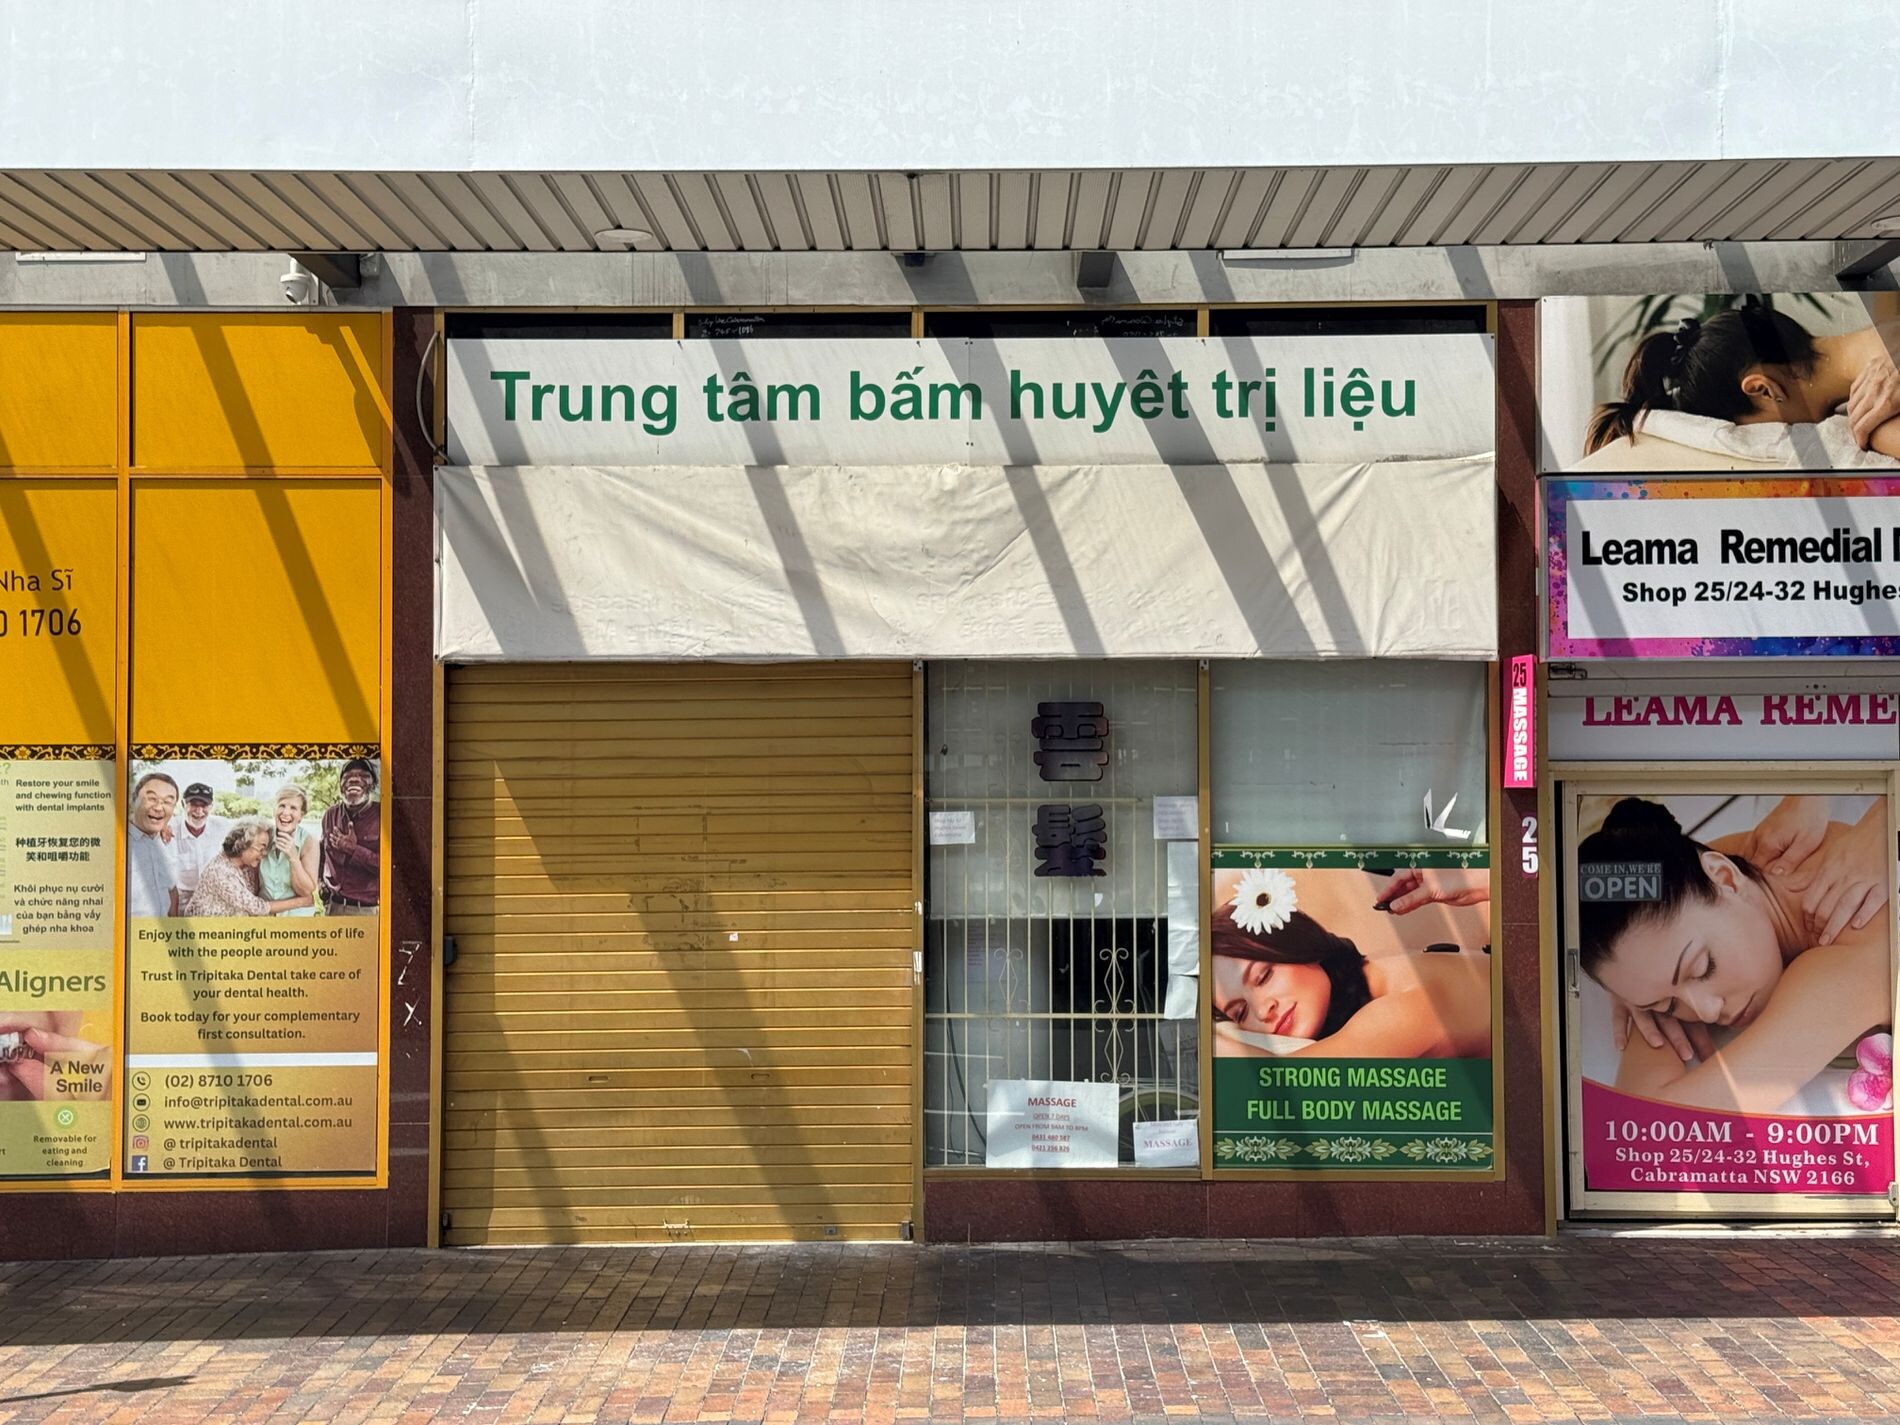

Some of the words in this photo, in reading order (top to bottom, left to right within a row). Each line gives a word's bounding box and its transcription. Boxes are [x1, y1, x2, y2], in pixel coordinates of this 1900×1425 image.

[490, 370, 677, 436] Trung
[703, 371, 820, 423] tâm
[850, 366, 982, 421] bấm
[1212, 367, 1276, 432] trị
[1304, 367, 1416, 431] liệu
[1582, 530, 1698, 565] Leama
[1720, 527, 1882, 564] Remedial
[51, 568, 73, 590] Sĩ
[1623, 582, 1686, 606] Shop
[1694, 580, 1806, 602] 25/24-32
[1814, 580, 1900, 605] Hughe
[20, 608, 81, 636] 1706
[1513, 662, 1526, 687] 25
[1582, 695, 1743, 725] LEAMA
[1513, 687, 1528, 782] MASSAGE
[15, 779, 50, 788] Restore
[53, 780, 73, 789] your
[75, 779, 100, 787] smile
[35, 791, 72, 801] chewing
[75, 791, 112, 799] function
[15, 803, 34, 811] with
[37, 803, 64, 811] dental
[67, 803, 105, 813] implants
[15, 837, 101, 848] 种植牙恢复您的微
[1580, 863, 1611, 875] COME
[39, 884, 63, 895] phục
[1584, 876, 1658, 899] OPEN
[82, 897, 103, 906] nhai
[50, 924, 68, 933] nha
[70, 923, 94, 933] khoa
[138, 929, 172, 942] Enjoy
[176, 929, 196, 940] the
[199, 928, 267, 941] meaningful
[270, 929, 327, 939] moments
[330, 928, 344, 939] of
[345, 928, 365, 938] life
[168, 946, 194, 957] with
[197, 946, 218, 957] the
[221, 946, 262, 960] people
[265, 946, 309, 957] around
[312, 947, 338, 959] you.
[141, 970, 173, 981] Trust
[176, 970, 187, 980] in
[190, 970, 244, 982] Tripitaka
[247, 969, 287, 980] Dental
[290, 969, 316, 979] take
[319, 970, 346, 979] care
[348, 969, 362, 979] of
[0, 969, 106, 998] Aligners
[193, 989, 221, 1001] your
[224, 987, 263, 998] dental
[266, 986, 309, 998] health.
[140, 1012, 172, 1022] Book
[174, 1012, 208, 1024] today
[212, 1011, 231, 1022] for
[233, 1013, 261, 1024] your
[264, 1010, 360, 1023] complementary
[198, 1029, 223, 1040] first
[225, 1029, 306, 1039] consultation.
[50, 1061, 63, 1075] A
[68, 1060, 104, 1075] New
[164, 1074, 194, 1088] (02)
[198, 1074, 233, 1087] 8710
[237, 1074, 273, 1087] 1706
[1259, 1067, 1341, 1088] STRONG
[1347, 1068, 1447, 1088] MASSAGE
[56, 1079, 103, 1093] Smile
[164, 1095, 353, 1110] info@tripitakadental.com.au
[1027, 1097, 1077, 1108] MASSAGE
[1247, 1100, 1296, 1120] FULL
[1302, 1101, 1355, 1120] BODY
[1362, 1101, 1462, 1121] MASSAGE
[164, 1116, 353, 1131] www.tripitakadental.com.au
[33, 1134, 82, 1144] Removable
[83, 1134, 97, 1144] for
[1606, 1120, 1732, 1143] 10:00AM
[1767, 1122, 1879, 1146] 9:00PM
[163, 1138, 176, 1150] @
[179, 1137, 277, 1152] tripitakadental
[1143, 1137, 1192, 1149] MASSAGE
[42, 1146, 70, 1157] eating
[71, 1146, 88, 1156] and
[1615, 1146, 1665, 1166] Shop
[1669, 1148, 1757, 1164] 25/24-32
[1763, 1149, 1837, 1168] Hughes
[1843, 1150, 1871, 1168] St,
[46, 1158, 84, 1168] cleaning
[163, 1158, 176, 1170] @
[179, 1156, 236, 1170] Tripitaka
[239, 1156, 282, 1168] Dental
[1630, 1166, 1748, 1183] Cabramatta
[1753, 1168, 1801, 1185] NSW
[1806, 1170, 1855, 1186] 2166
